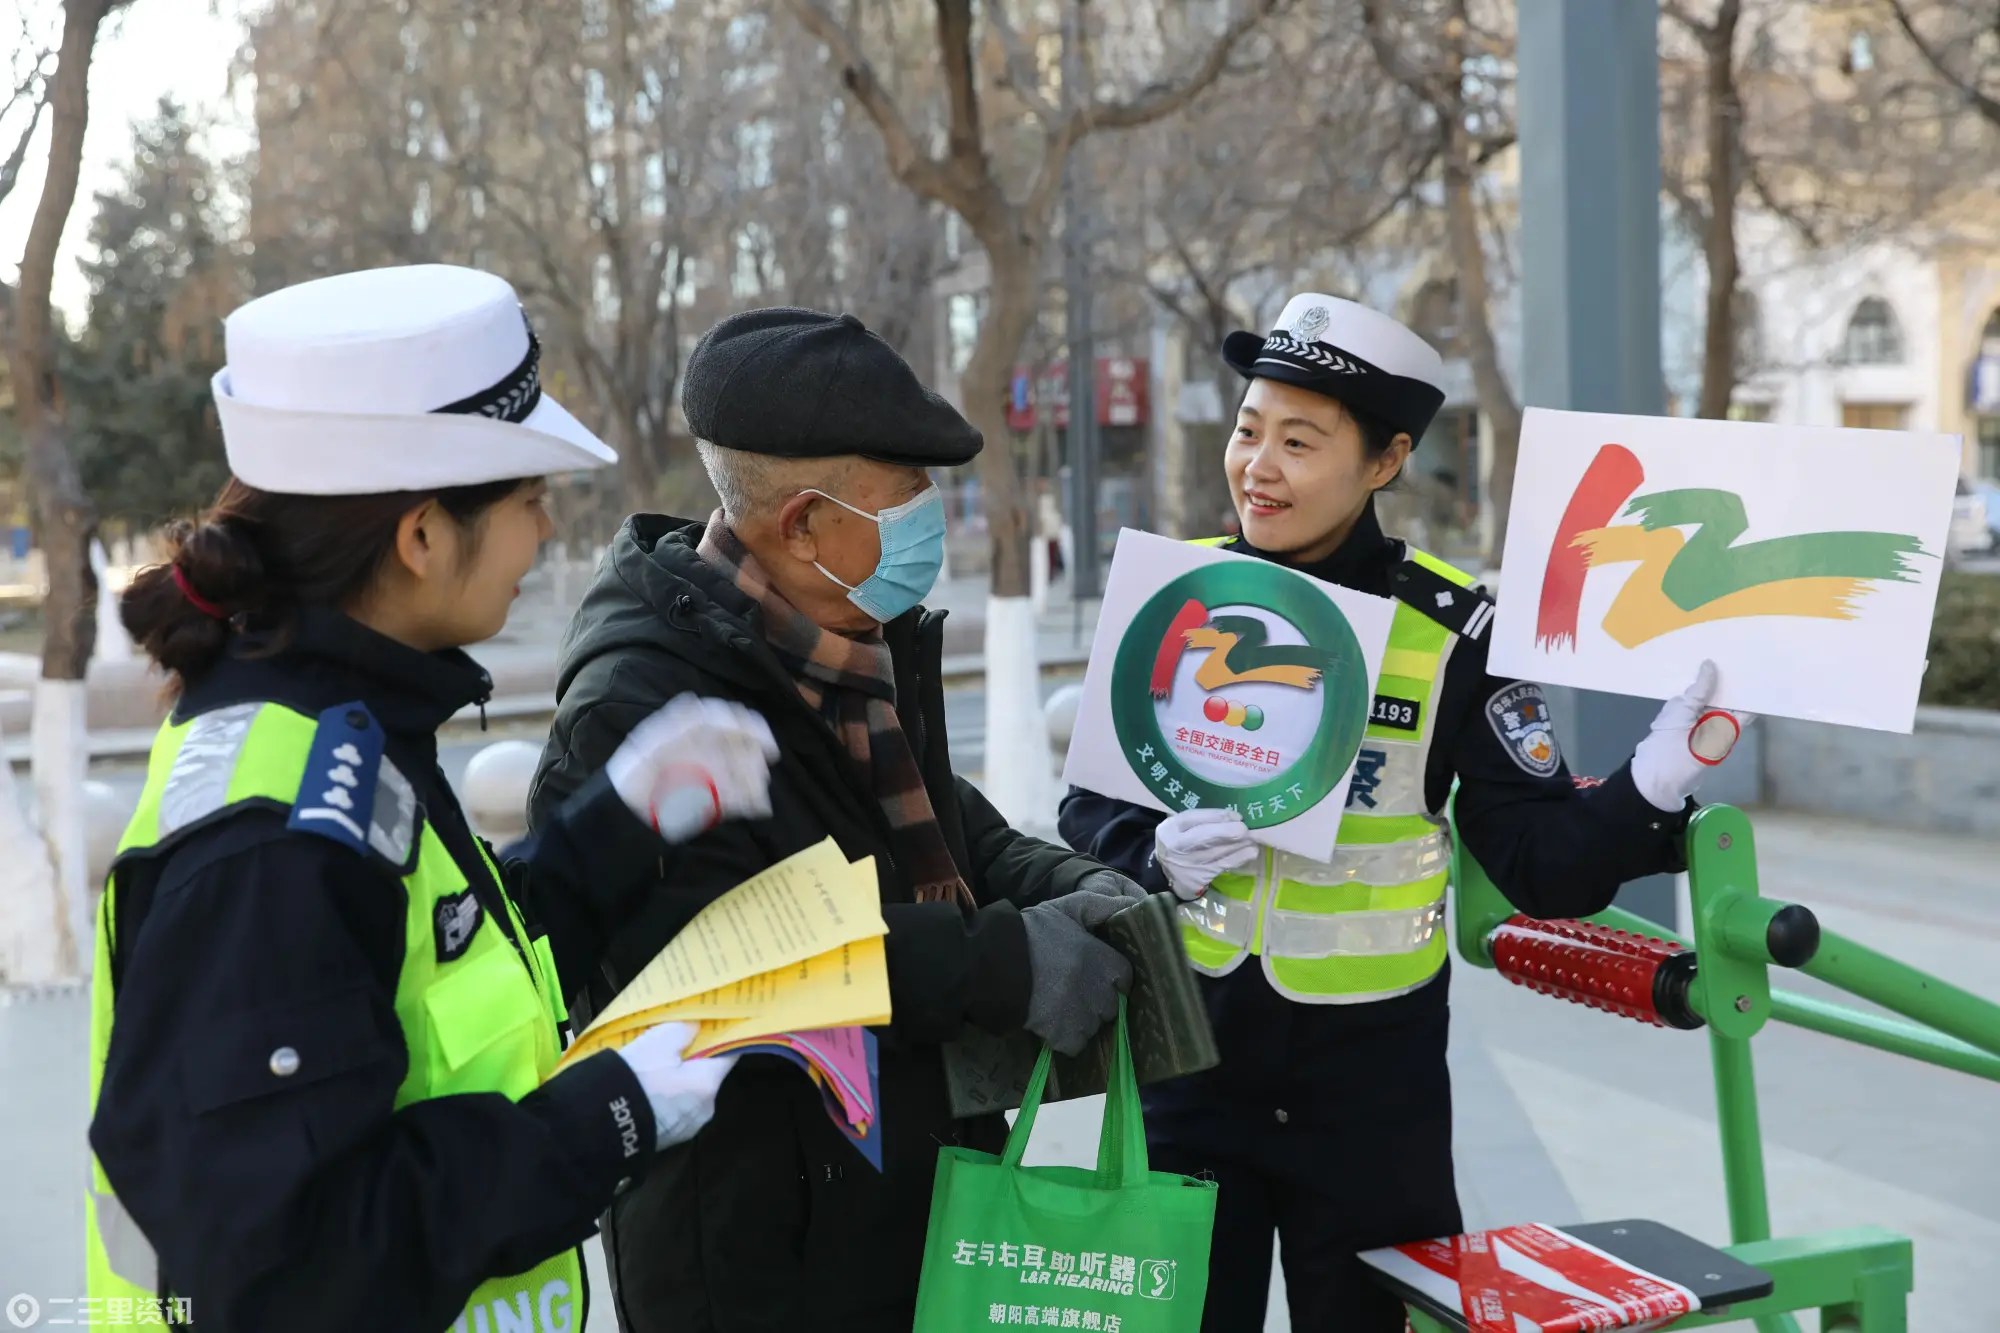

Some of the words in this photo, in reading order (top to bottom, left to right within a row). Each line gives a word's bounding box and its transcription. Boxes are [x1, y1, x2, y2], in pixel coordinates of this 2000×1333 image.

[1175, 727, 1280, 766] 全国交通安全日
[1176, 744, 1206, 757] NATIONAL
[1208, 752, 1233, 764] TRAFFIC
[1233, 759, 1258, 771] SAFETY
[1258, 766, 1272, 774] DAY
[1136, 742, 1201, 809] 文明交通
[608, 1096, 639, 1158] POLICE
[952, 1239, 1136, 1283] 左与右耳助听器
[1020, 1270, 1051, 1285] L&R
[1053, 1273, 1134, 1296] HEARING
[453, 1279, 573, 1333] ING
[988, 1302, 1122, 1333] 朝阳高端旗舰店
